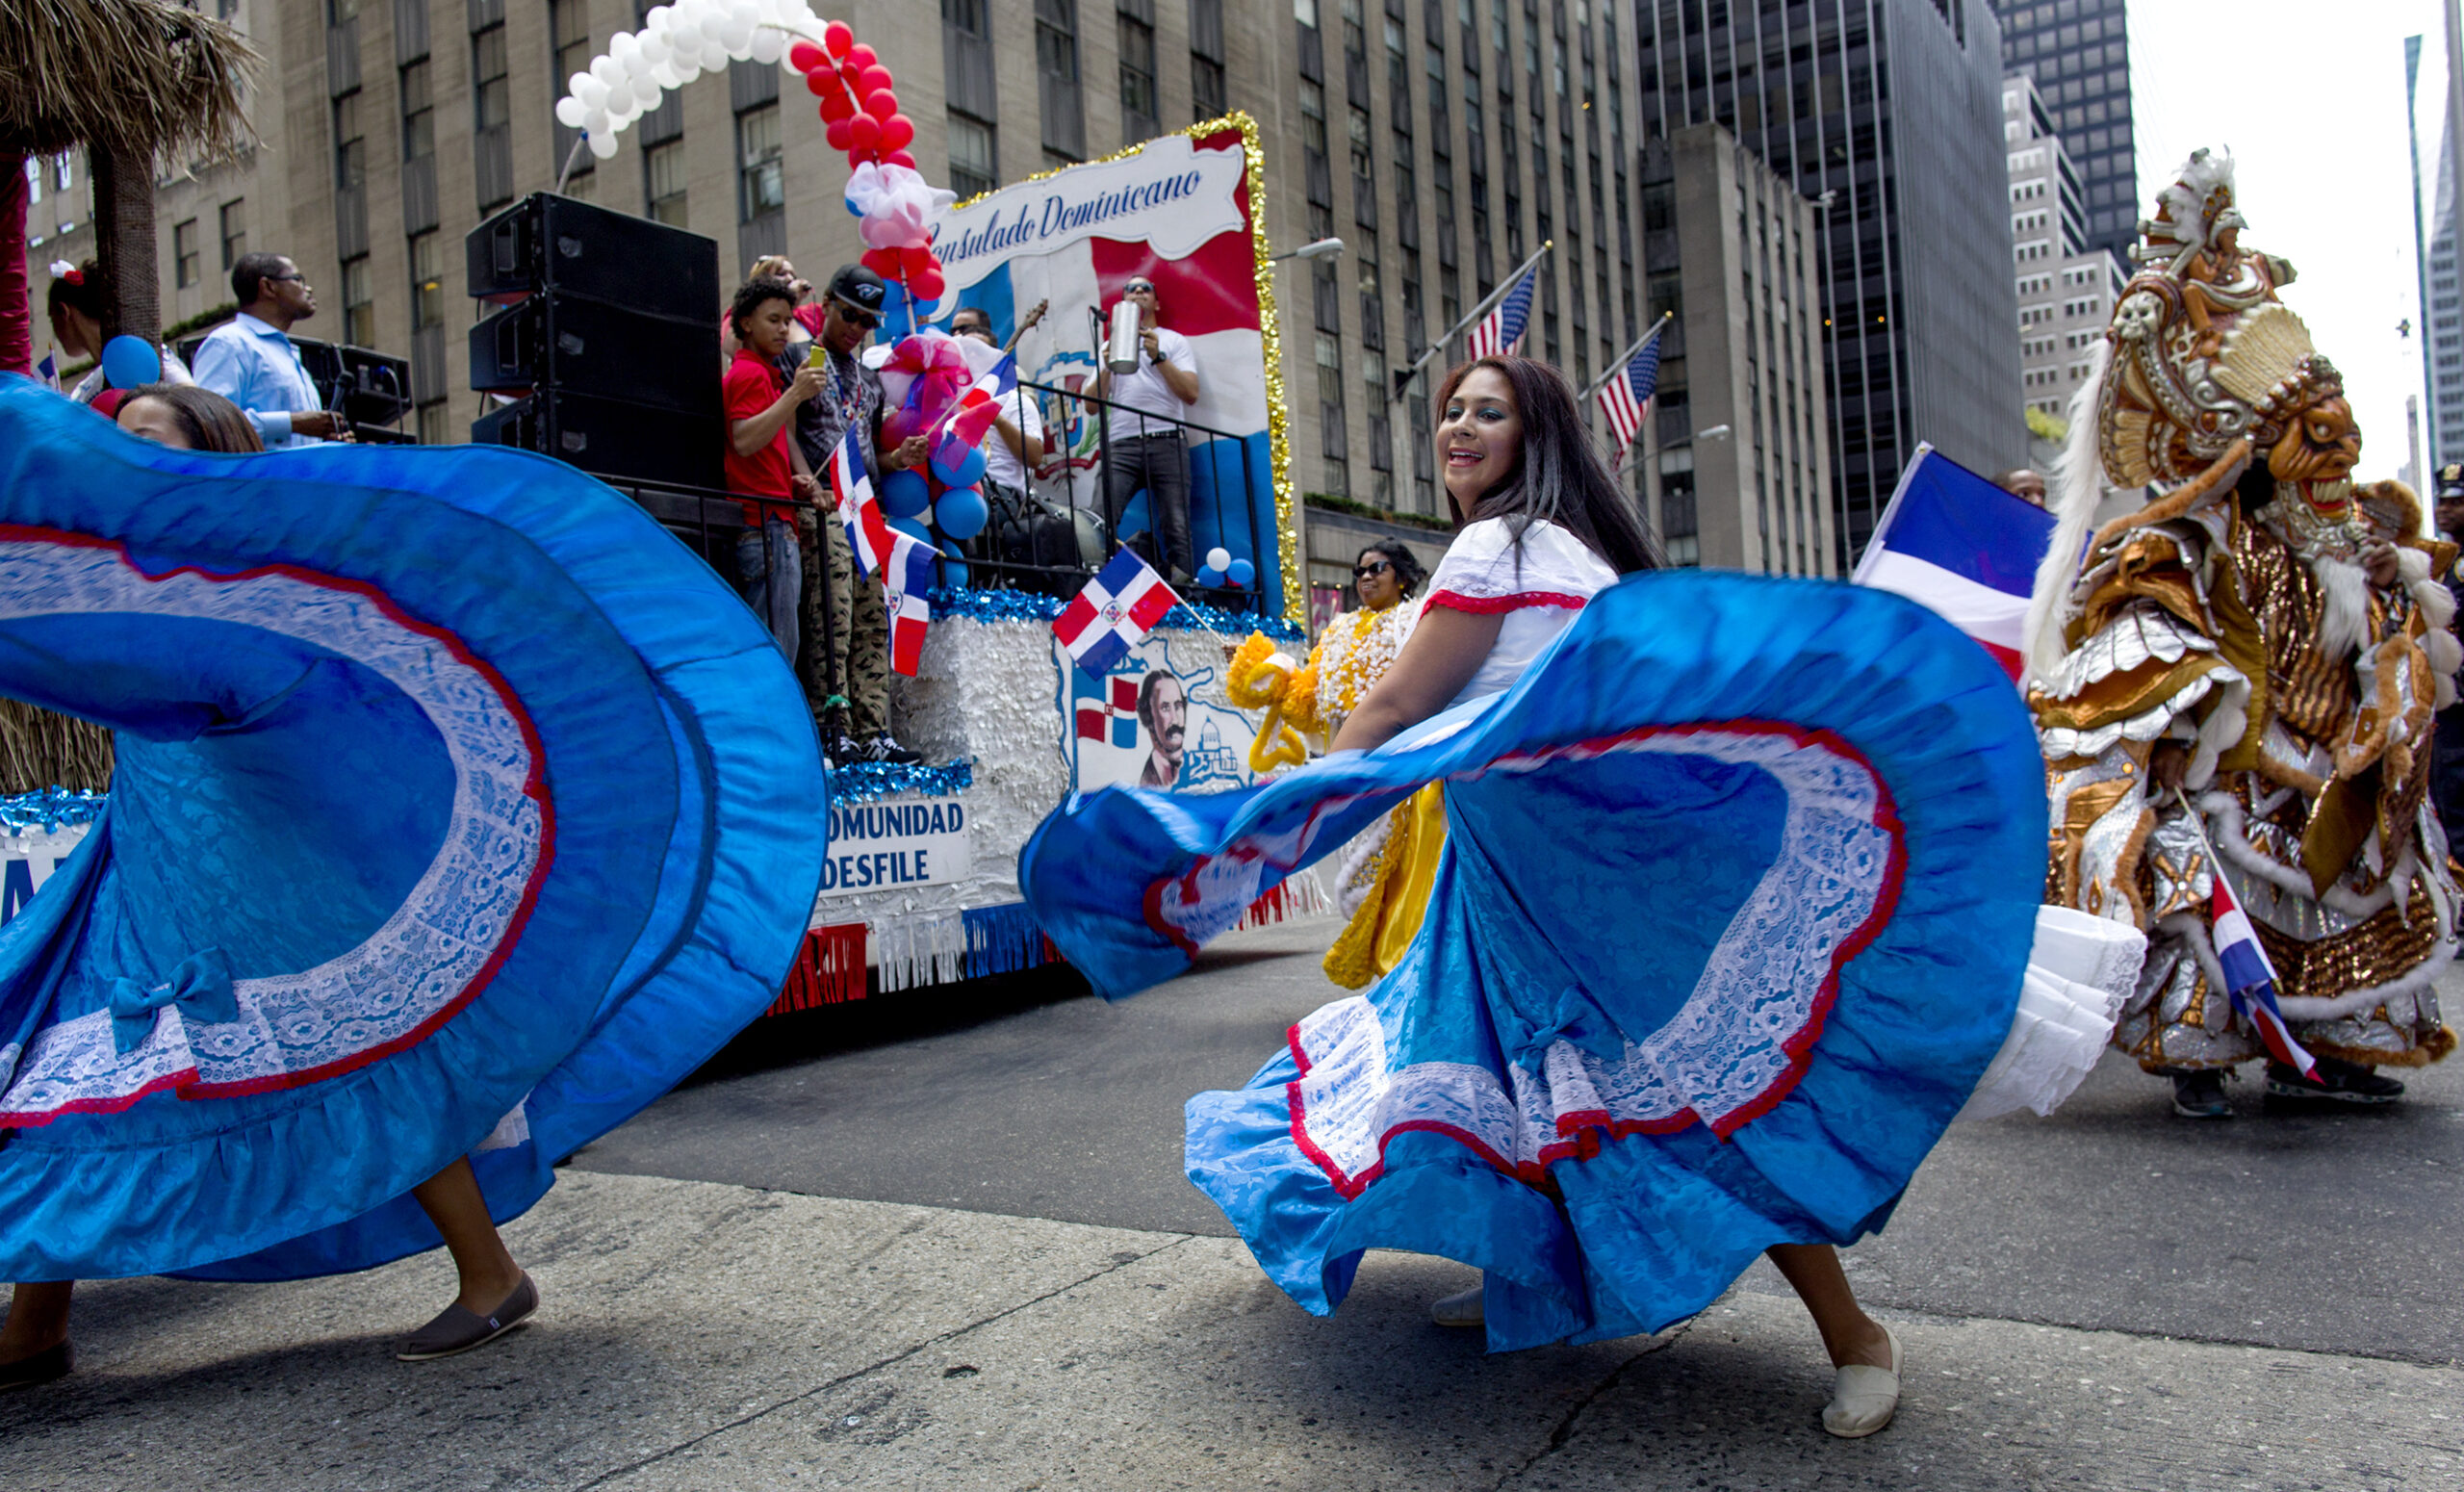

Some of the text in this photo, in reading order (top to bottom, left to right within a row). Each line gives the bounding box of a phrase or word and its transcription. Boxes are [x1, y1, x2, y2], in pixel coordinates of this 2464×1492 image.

[930, 169, 1202, 265] onsulado Dominicano
[820, 850, 930, 890] DESFILE
